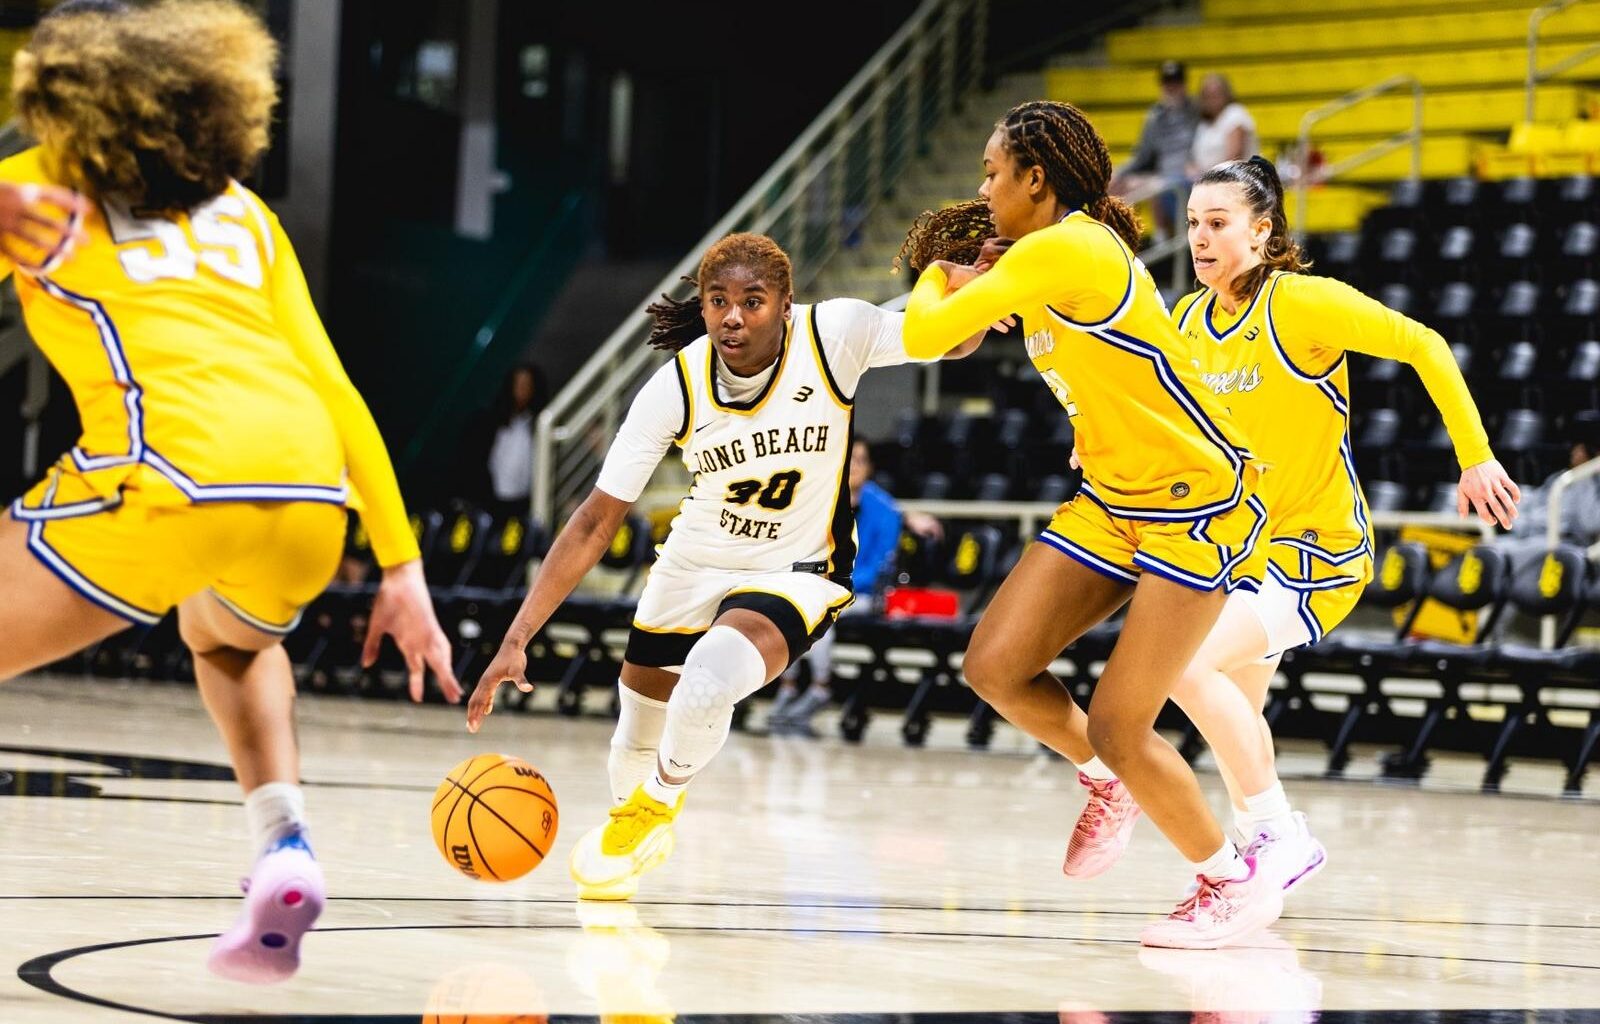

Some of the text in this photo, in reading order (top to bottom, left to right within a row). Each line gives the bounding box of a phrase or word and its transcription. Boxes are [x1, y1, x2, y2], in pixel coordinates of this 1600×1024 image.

[104, 195, 264, 289] 55
[752, 425, 829, 458] BEACH
[724, 469, 802, 511] 30
[720, 508, 782, 540] STATE
